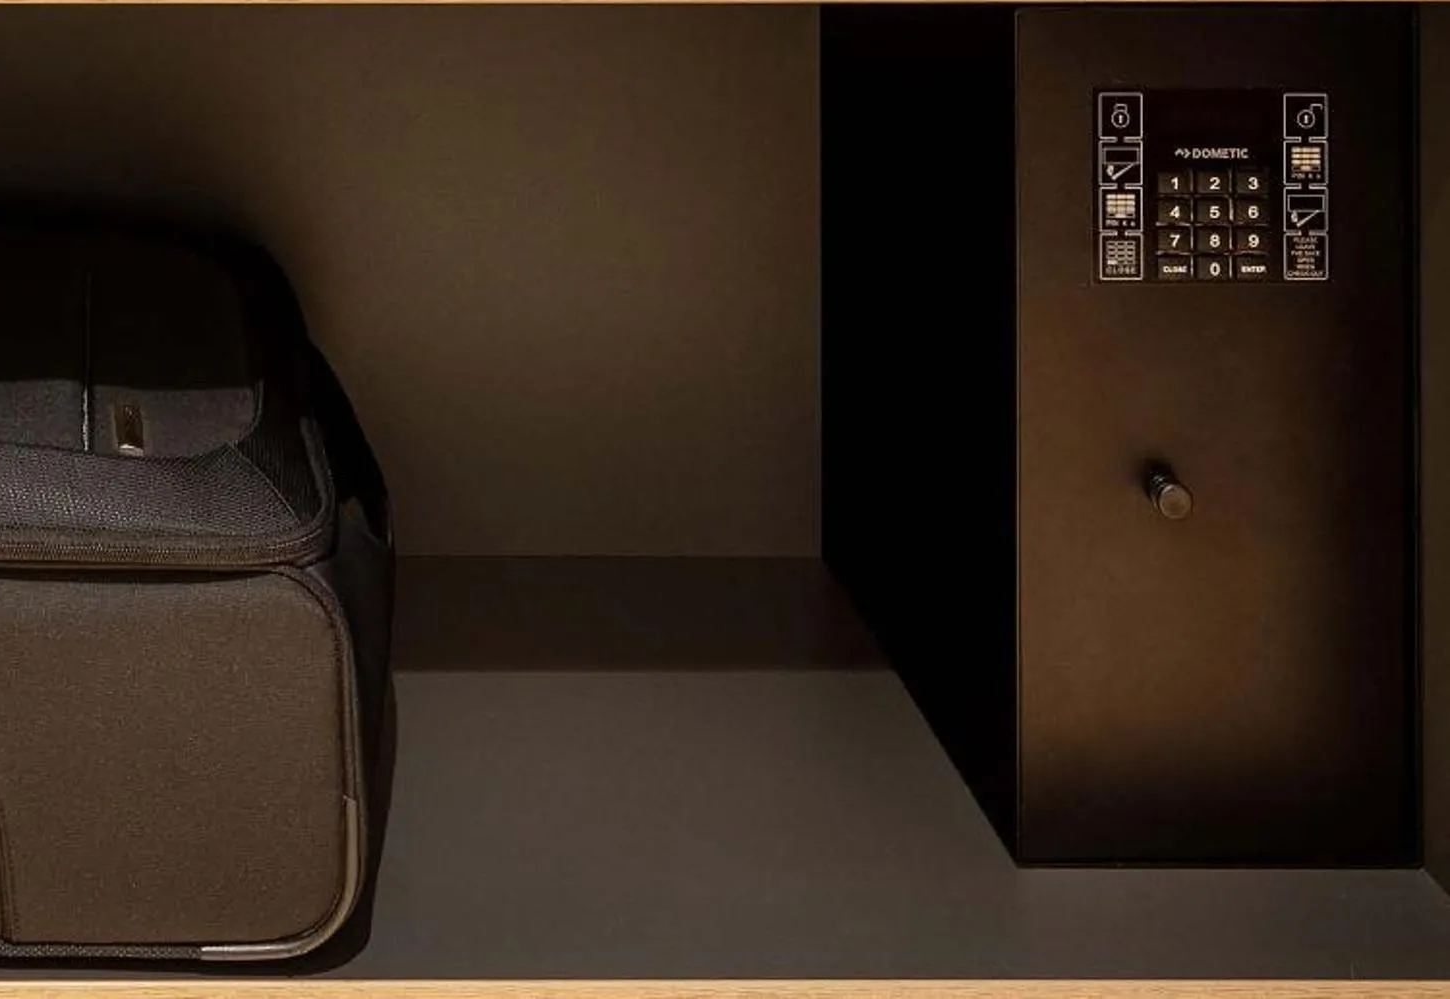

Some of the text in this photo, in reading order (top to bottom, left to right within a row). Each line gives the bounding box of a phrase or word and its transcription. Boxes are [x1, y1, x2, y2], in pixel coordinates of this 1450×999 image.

[1191, 147, 1249, 159] DOMETIC
[1171, 176, 1259, 190] 1 2 3
[1170, 205, 1259, 219] 4 5 6
[1170, 234, 1260, 248] 7 8 9
[1209, 262, 1221, 276] 0
[1241, 265, 1267, 273] ENTER
